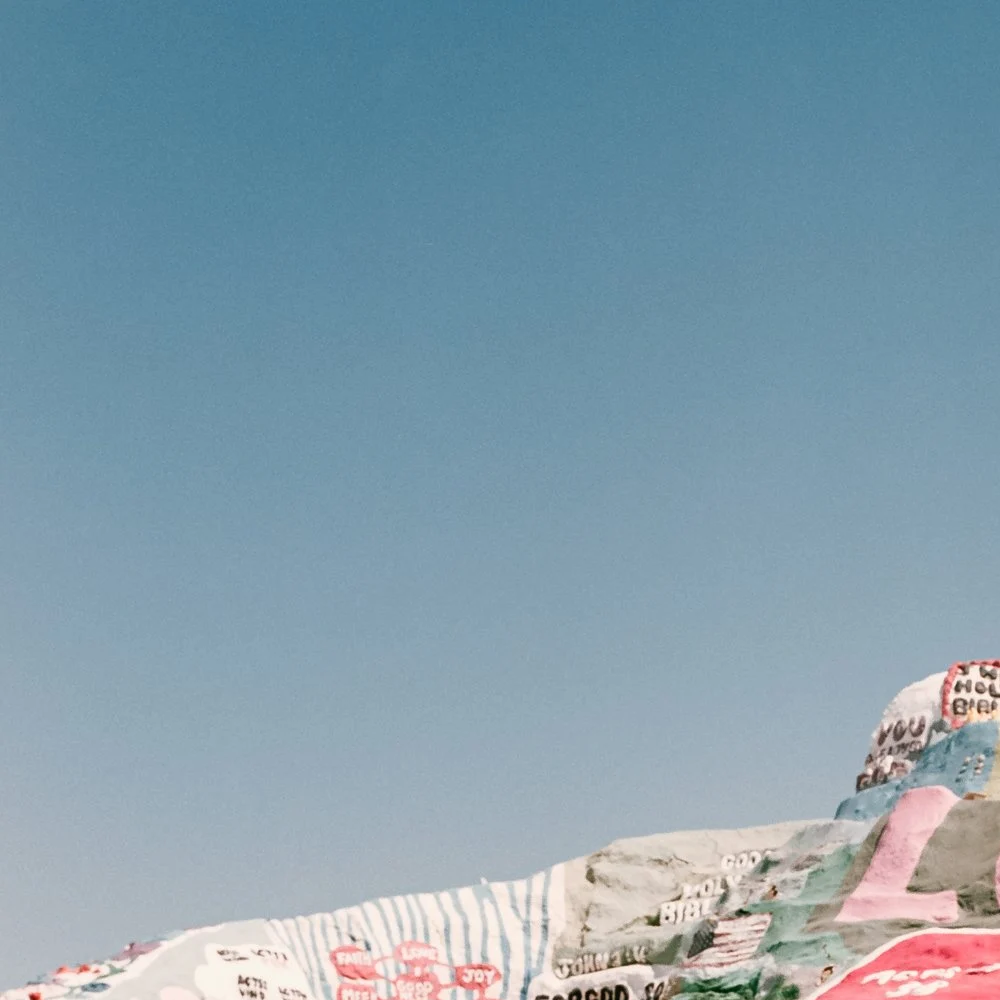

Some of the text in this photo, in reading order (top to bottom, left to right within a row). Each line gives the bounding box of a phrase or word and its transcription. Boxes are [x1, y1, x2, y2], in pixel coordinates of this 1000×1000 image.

[877, 715, 926, 746] YOU
[721, 850, 772, 869] GOD
[660, 899, 712, 925] BIBL
[462, 968, 497, 986] JOY
